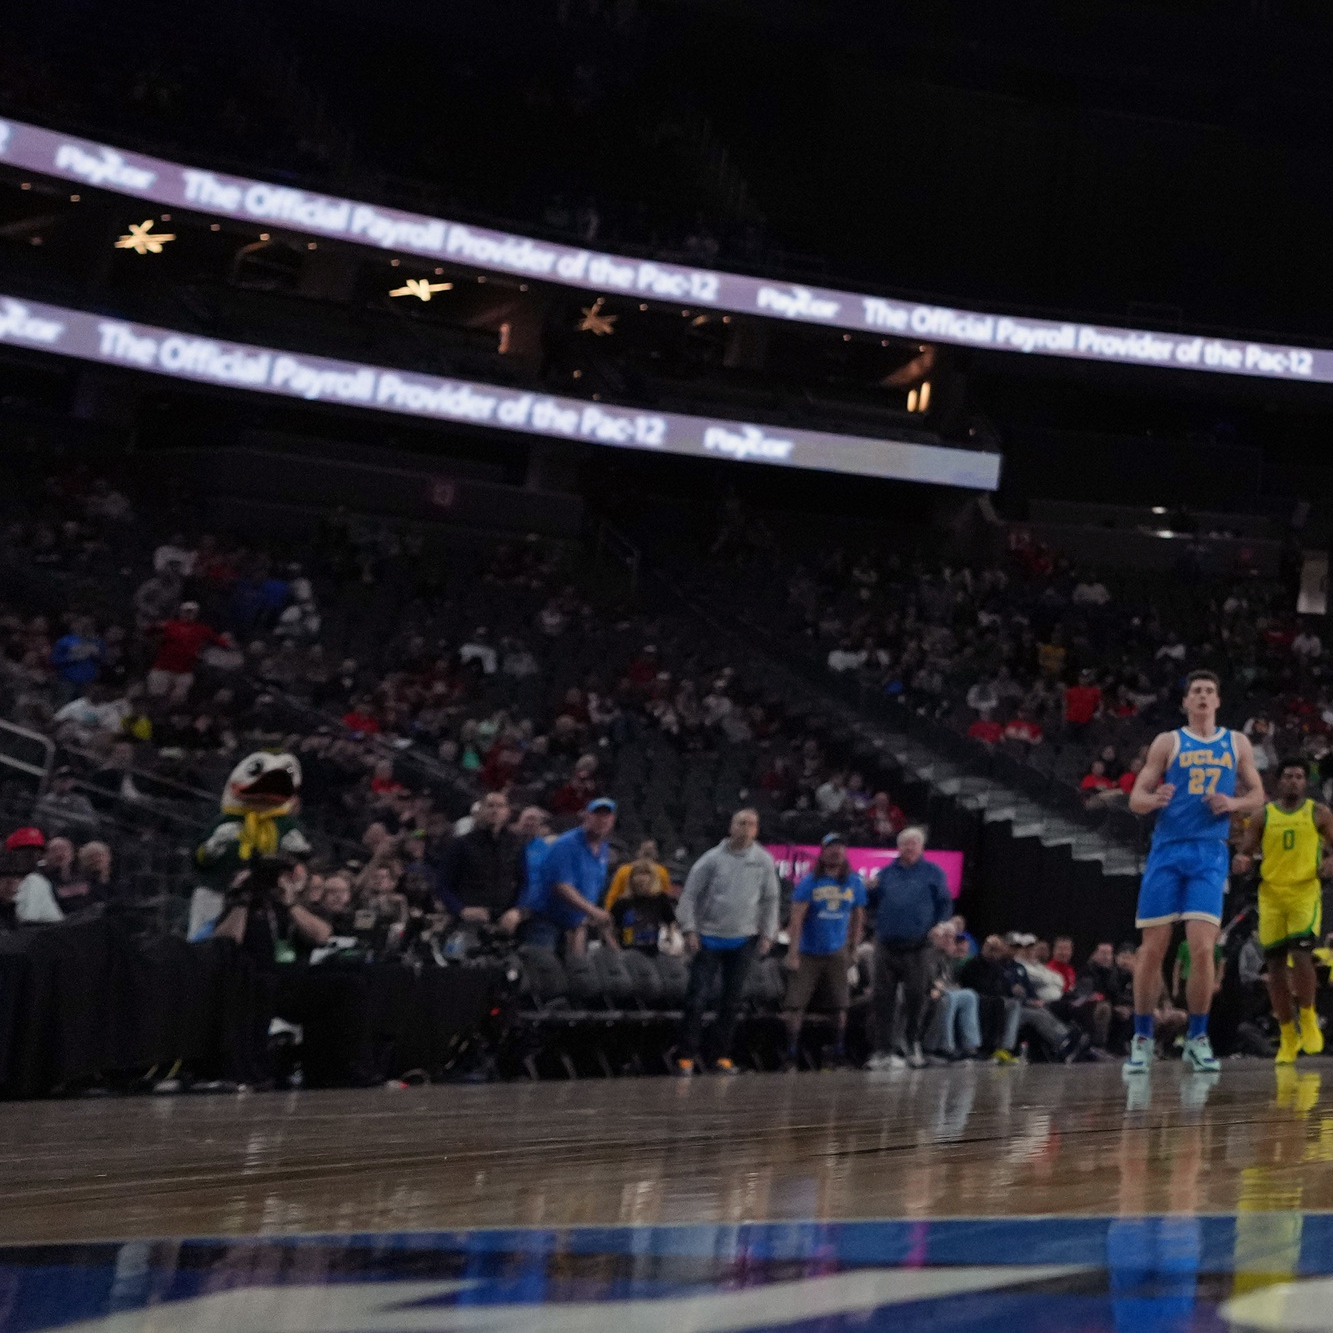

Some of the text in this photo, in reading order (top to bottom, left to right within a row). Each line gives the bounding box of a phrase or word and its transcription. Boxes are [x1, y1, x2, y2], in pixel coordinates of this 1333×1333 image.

[183, 170, 717, 302] The Official Payroll Provider of the Pac-12
[863, 295, 1315, 376] The Official Payroll Provider of the Pac-12
[99, 322, 665, 445] The Official Payroll Provider of the Pac-12
[1179, 748, 1234, 767] UCLA
[1188, 768, 1222, 795] 27
[1282, 829, 1295, 850] 0
